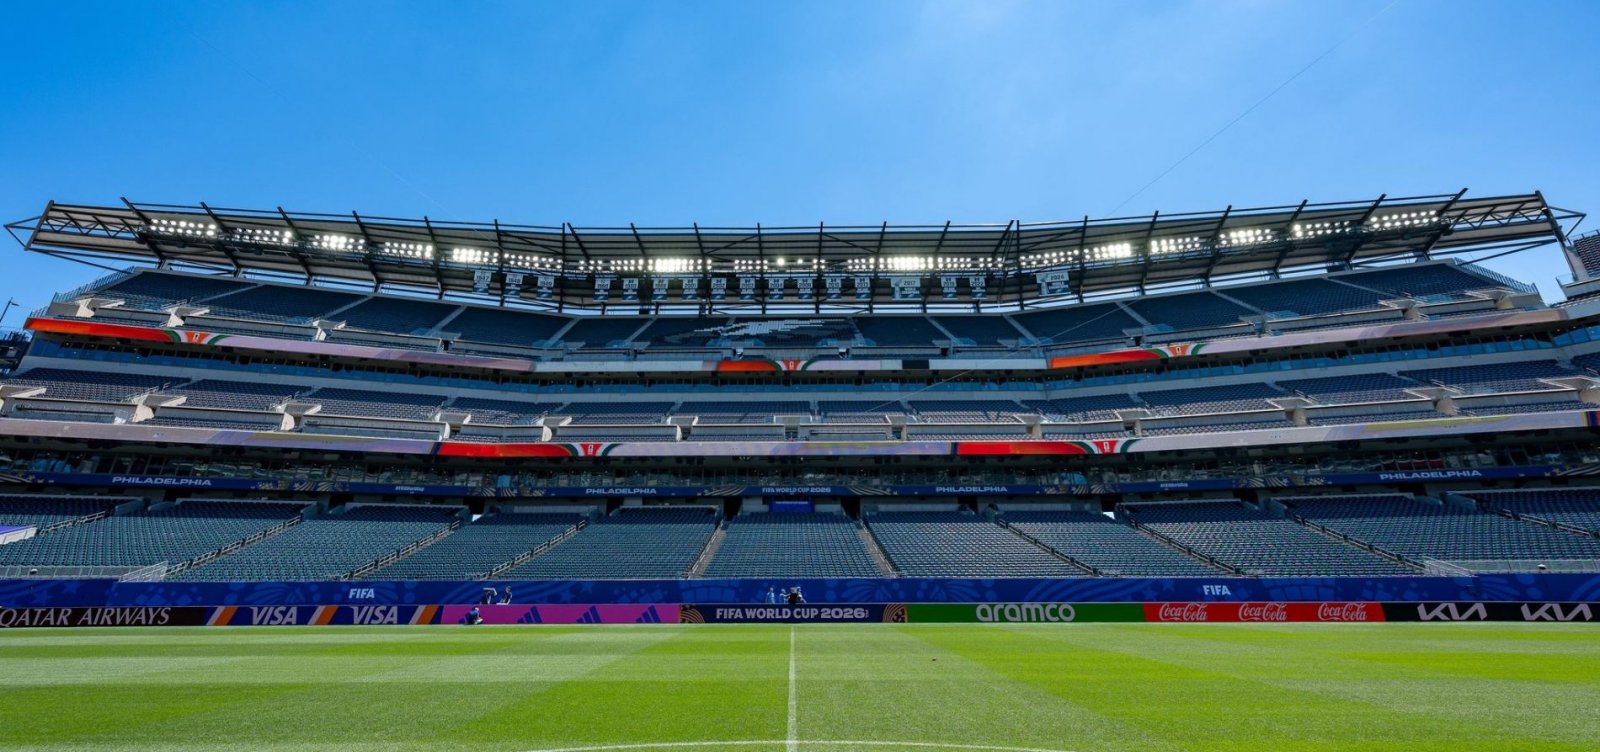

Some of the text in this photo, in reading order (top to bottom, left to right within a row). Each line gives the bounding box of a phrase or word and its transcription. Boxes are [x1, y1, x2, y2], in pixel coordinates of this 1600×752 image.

[112, 476, 212, 486] PHILADELPHIA
[1379, 470, 1482, 480] PHILADELPHIA
[349, 588, 375, 599] FIFA
[1203, 585, 1231, 596] FIFA
[0, 607, 171, 627] QATAR AIRWAYS
[250, 606, 298, 625] VISA
[350, 606, 398, 625] VISA
[716, 608, 743, 619] FIFA
[744, 608, 791, 619] WORLD
[793, 608, 819, 619] CUP
[820, 608, 865, 619] 2026
[976, 603, 1076, 622] aramco
[1159, 602, 1208, 622] Coca-Cola
[1239, 602, 1287, 622] Coca-Cola
[1318, 602, 1367, 622] Coca-Cola
[1417, 602, 1488, 621] KIA
[1521, 602, 1593, 621] KIA
